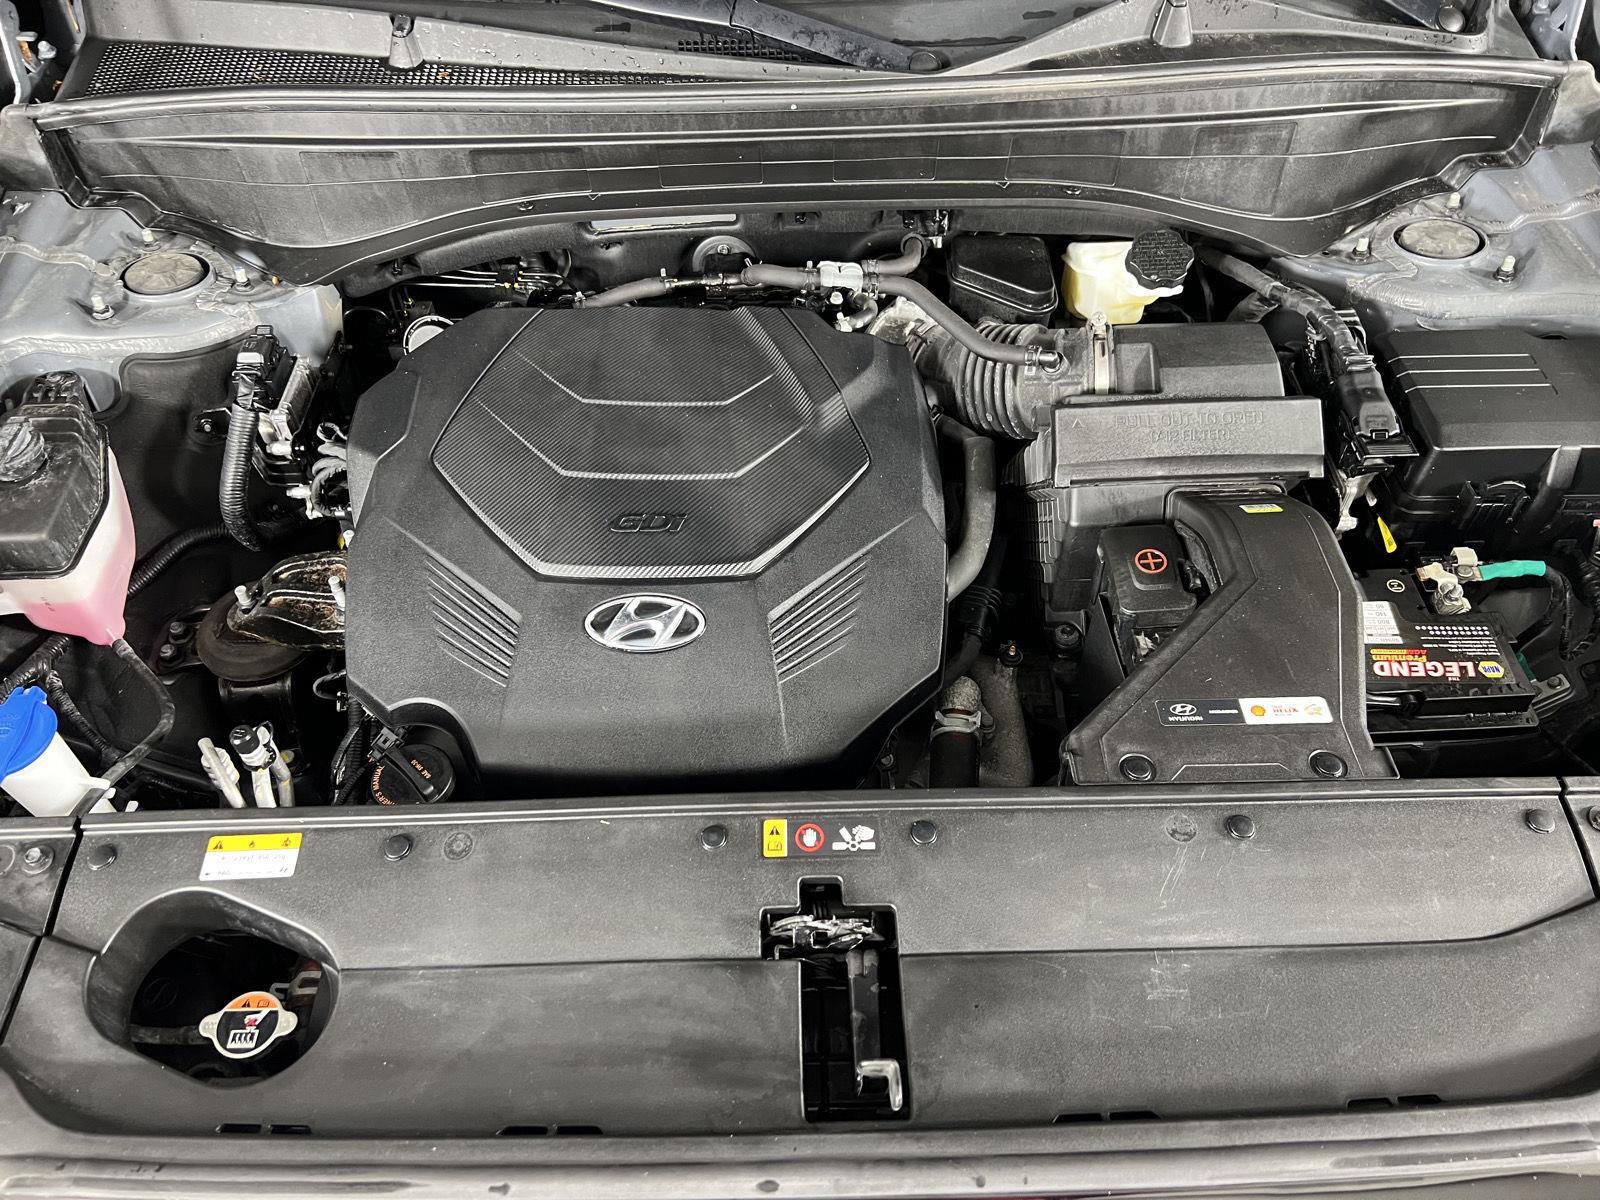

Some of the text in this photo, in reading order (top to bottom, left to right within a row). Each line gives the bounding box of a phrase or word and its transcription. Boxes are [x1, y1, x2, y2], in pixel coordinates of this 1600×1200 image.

[1114, 410, 1264, 428] PULL OUT TO OPEN
[1372, 655, 1427, 663] Premium
[1373, 661, 1477, 677] LEGEND
[1481, 665, 1501, 673] NAPA
[372, 765, 385, 791] MANUAL
